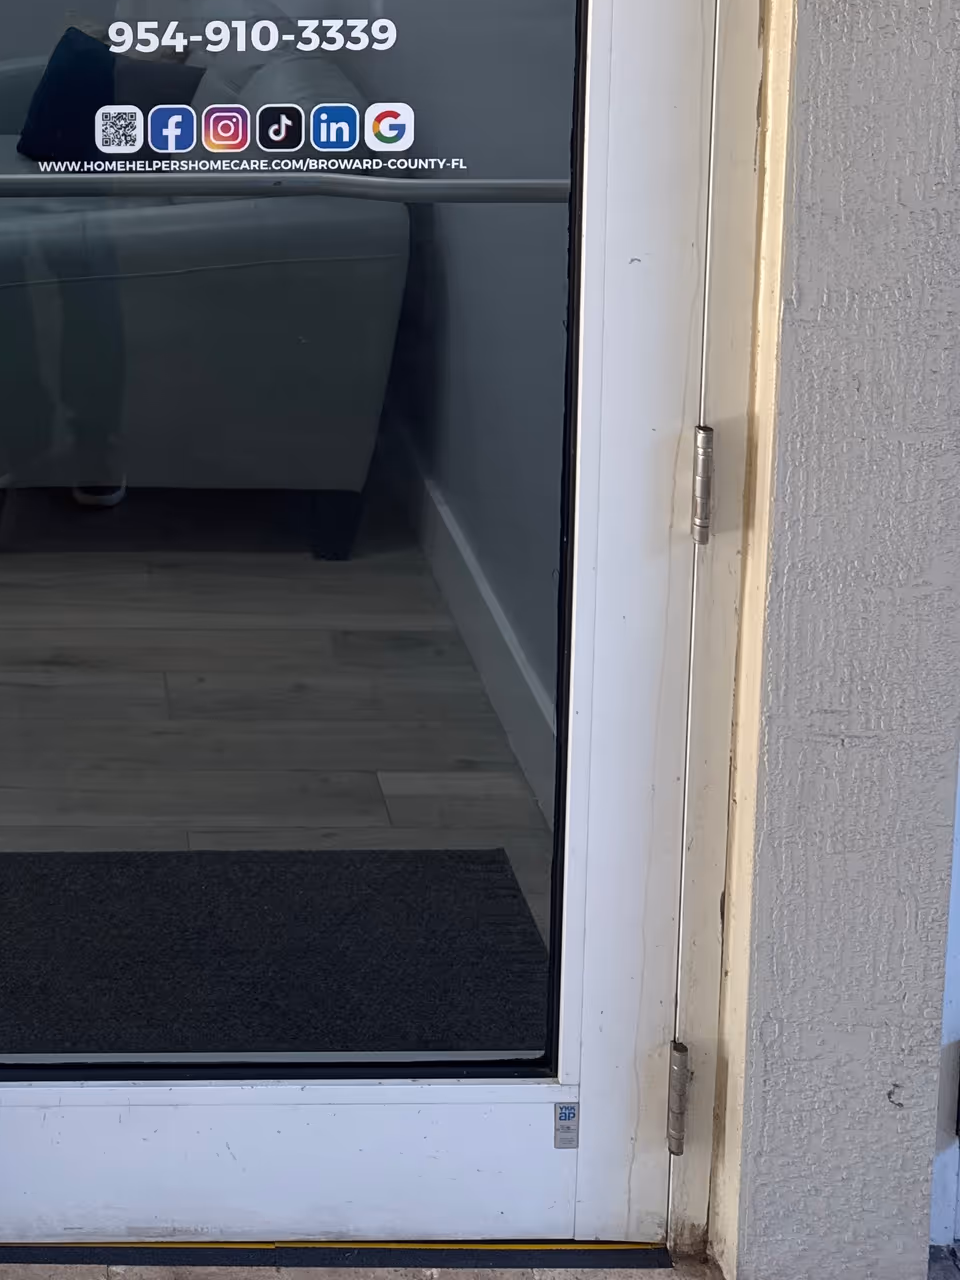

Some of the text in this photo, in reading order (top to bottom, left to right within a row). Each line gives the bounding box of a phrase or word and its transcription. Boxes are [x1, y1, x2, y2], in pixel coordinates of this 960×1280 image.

[107, 18, 398, 54] 954-910-3339
[319, 112, 351, 144] in
[38, 158, 468, 173] WWW.HOMEHELPERSHOMECARE.COM/BROWARD-COUNTY-FL
